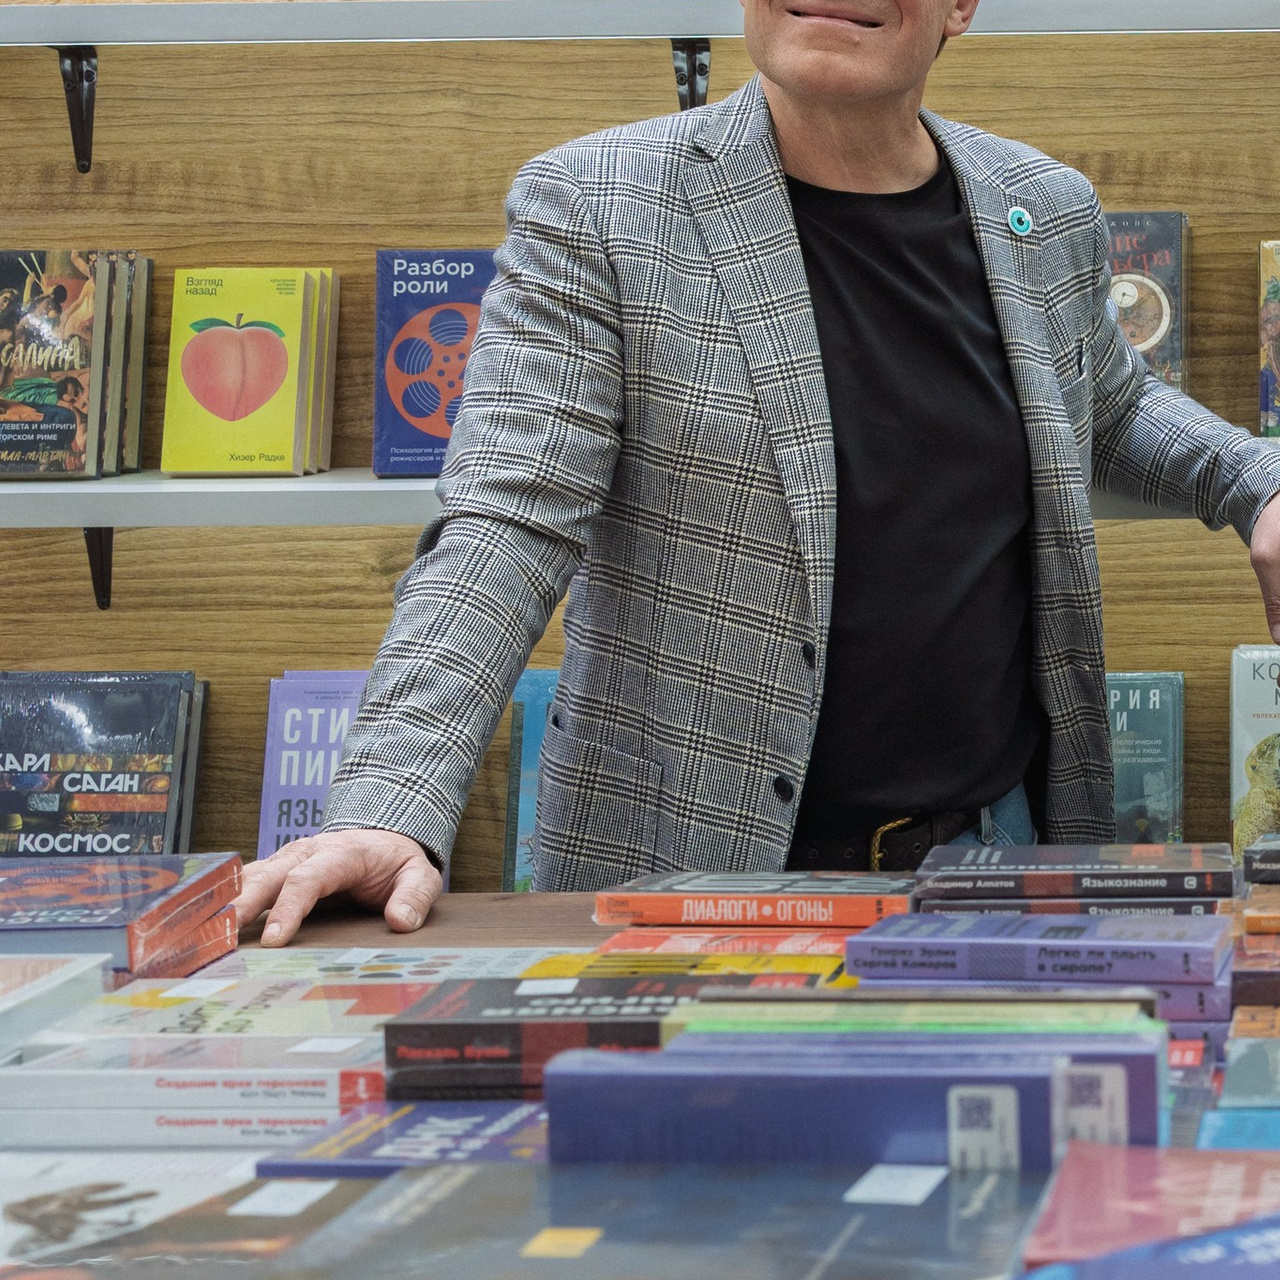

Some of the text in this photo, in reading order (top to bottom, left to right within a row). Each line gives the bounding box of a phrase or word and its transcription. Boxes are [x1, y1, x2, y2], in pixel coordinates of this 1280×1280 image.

[393, 259, 475, 278] Разбор
[186, 277, 223, 287] Взгляд
[185, 287, 217, 296] назад
[392, 280, 448, 297] роли
[40, 423, 77, 431] ИНТРИГИ
[36, 433, 58, 441] РИМЕ
[229, 453, 285, 463] Хизер Радке
[63, 773, 140, 793] САГАН
[18, 833, 131, 853] КОСМОС
[926, 880, 974, 889] Владимир
[976, 879, 1016, 888] Алпатов
[1081, 877, 1168, 888] Языкознание
[681, 899, 834, 922] ДИАЛОГИ ОГОНЬ!
